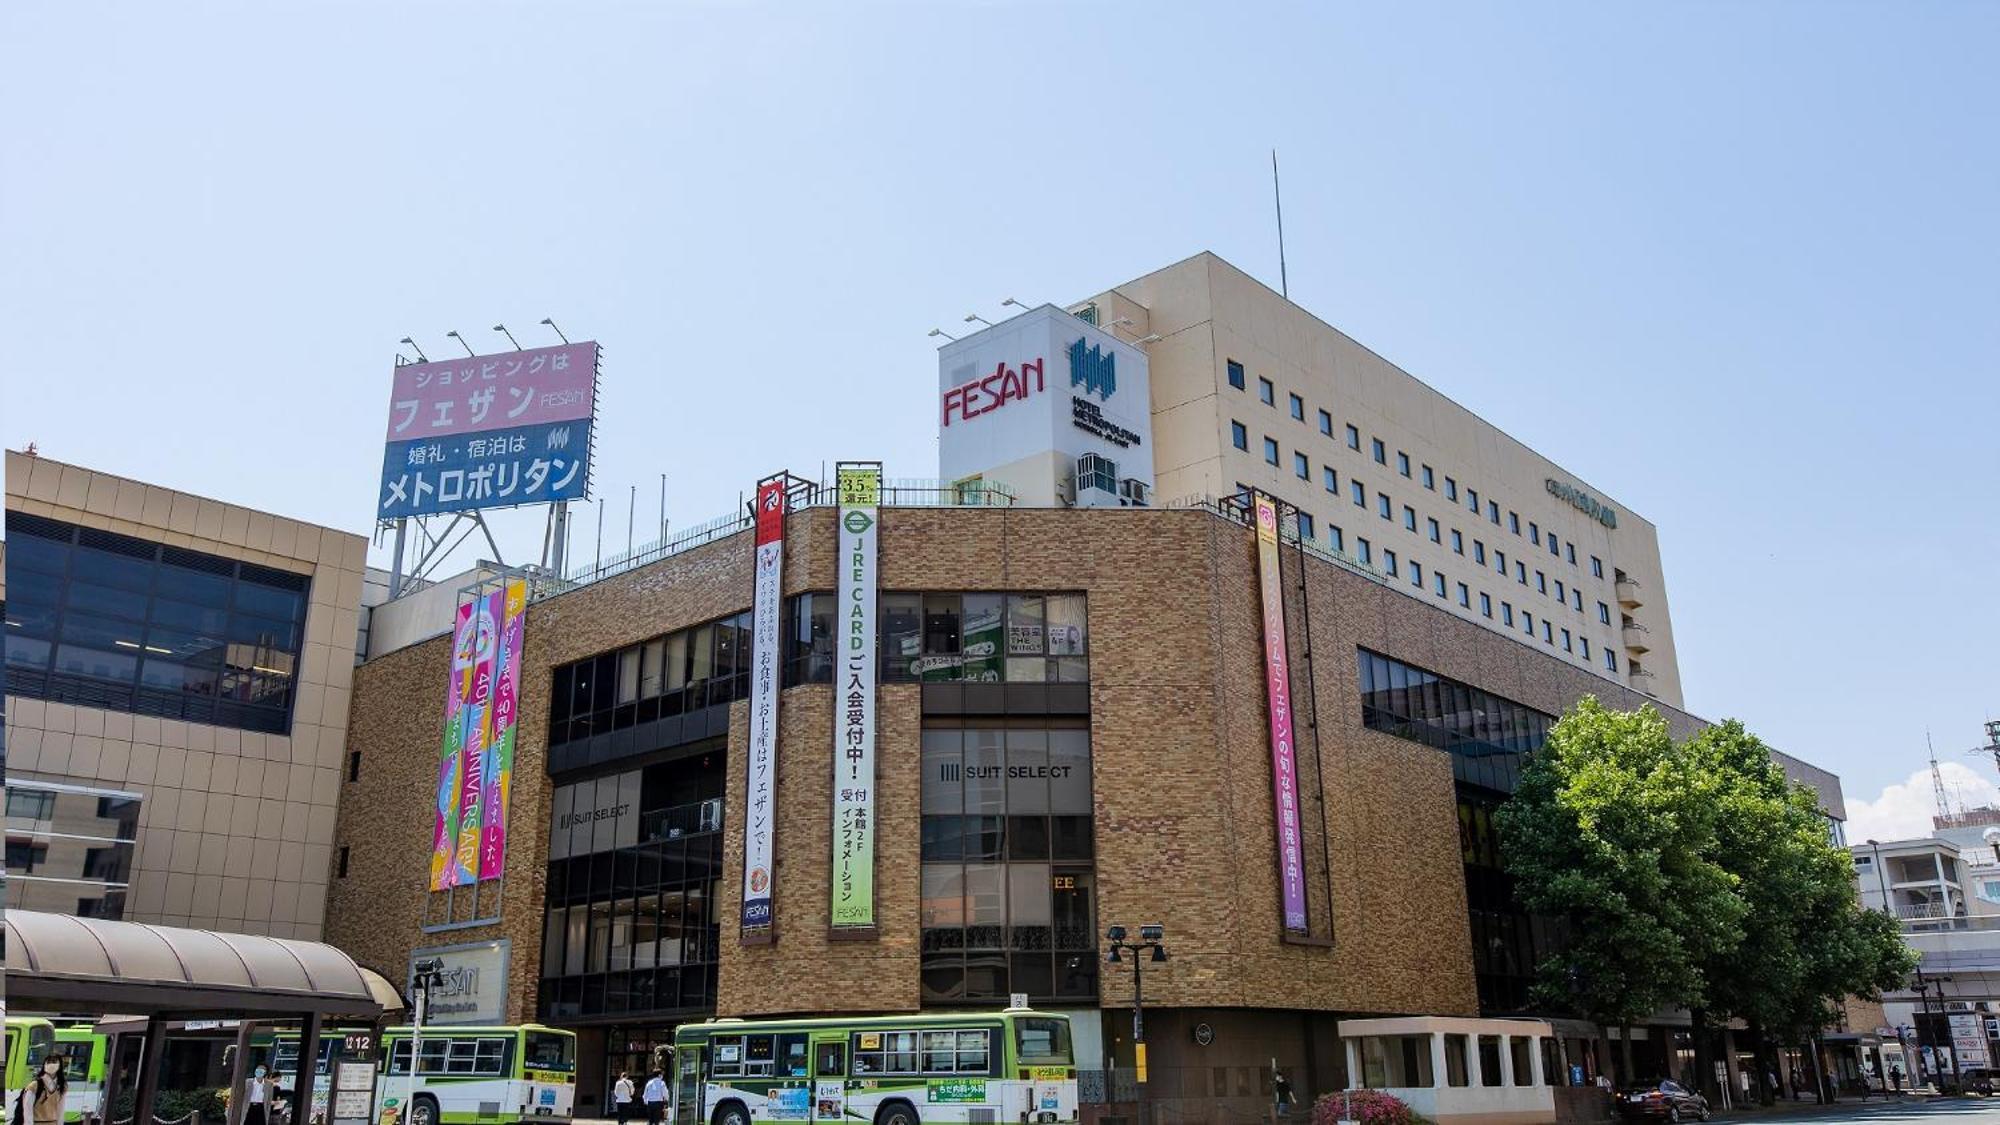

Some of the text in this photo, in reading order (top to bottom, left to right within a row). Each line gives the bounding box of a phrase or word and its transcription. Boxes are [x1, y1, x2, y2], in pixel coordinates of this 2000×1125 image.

[416, 352, 570, 389] ショッピングは
[943, 357, 1045, 427] FESAN
[1073, 395, 1104, 418] HOTEL
[395, 386, 536, 433] フェザン
[408, 435, 526, 466] 婚礼・宿泊は
[384, 457, 580, 509] メトロポリタン
[966, 766, 1072, 779] SUIT SELECT
[840, 788, 867, 802] 受付
[594, 804, 630, 821] SELECT
[841, 808, 852, 902] インフォメーション
[355, 1036, 370, 1049] 12
